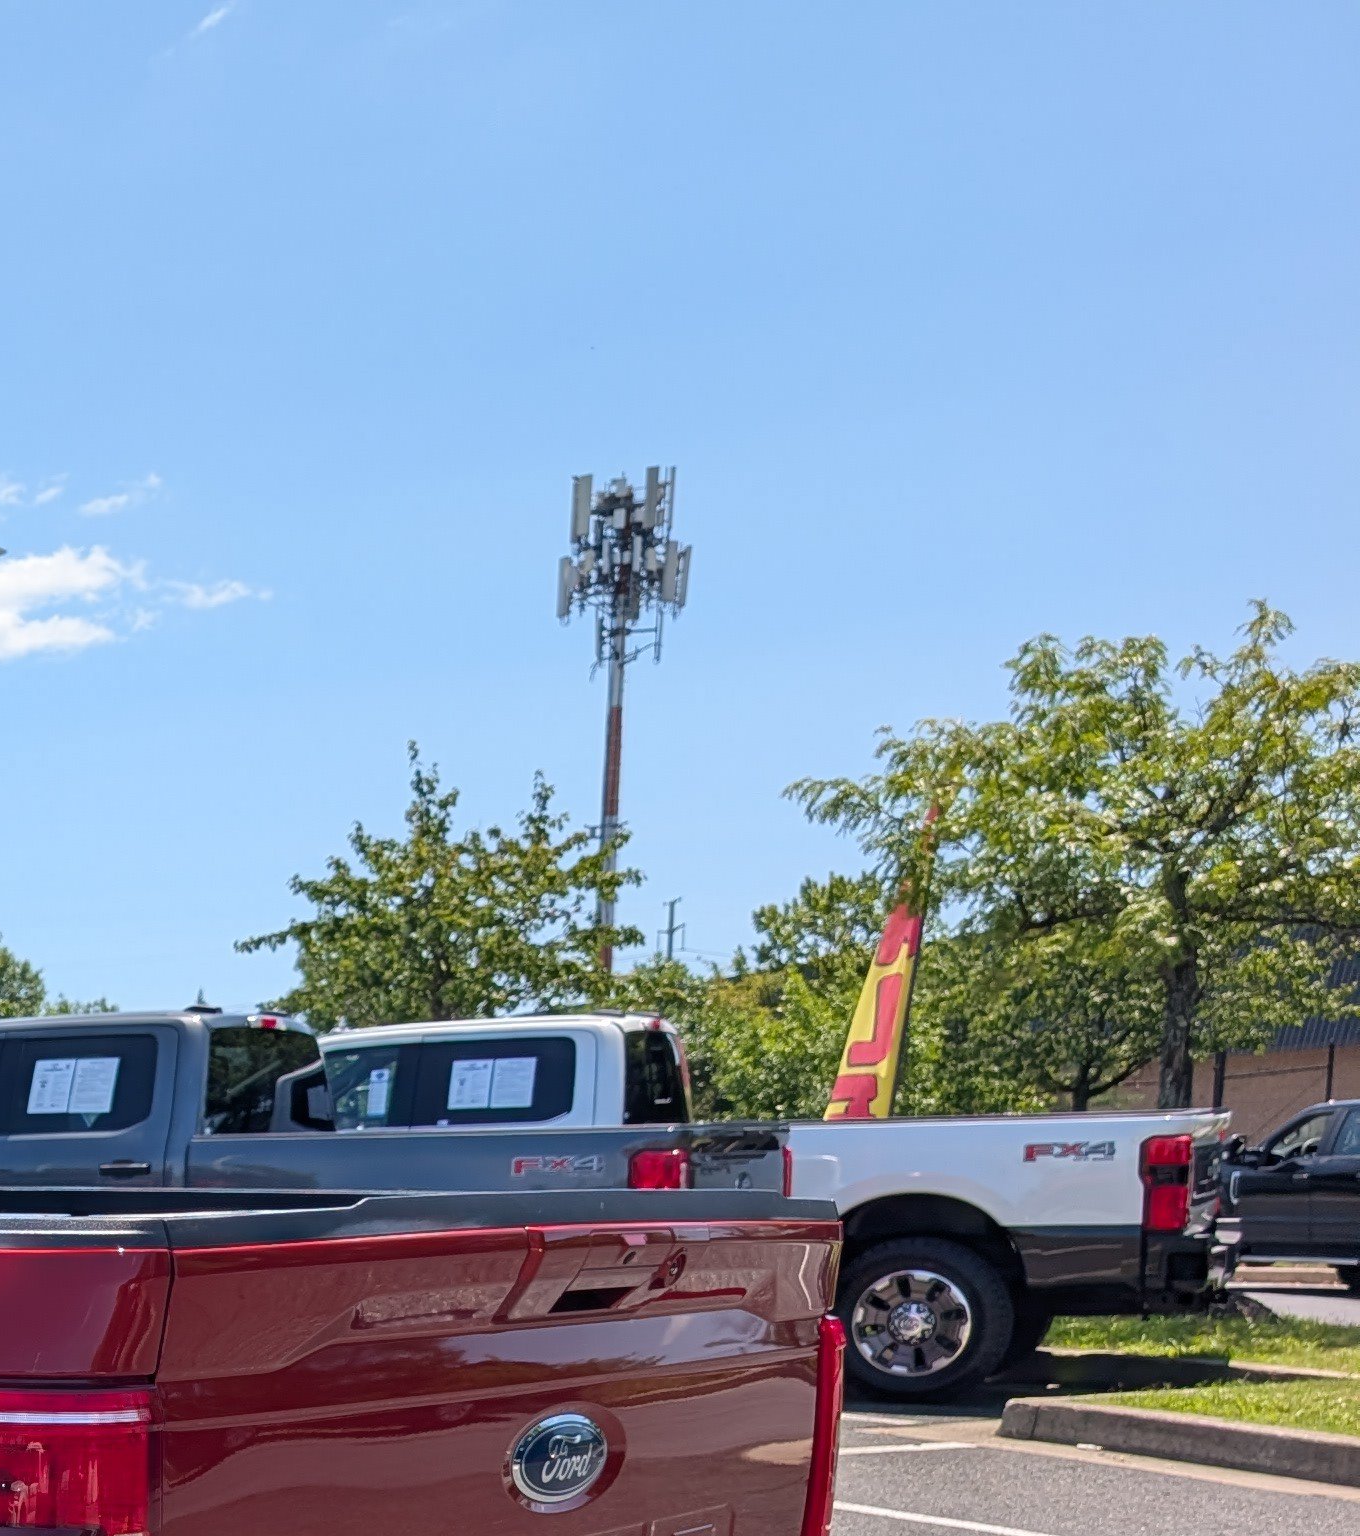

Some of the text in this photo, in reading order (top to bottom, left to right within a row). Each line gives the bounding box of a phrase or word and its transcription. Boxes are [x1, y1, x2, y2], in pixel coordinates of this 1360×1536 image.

[1023, 1141, 1116, 1162] FX4
[511, 1154, 605, 1177] FX4
[541, 1434, 593, 1484] Ford
